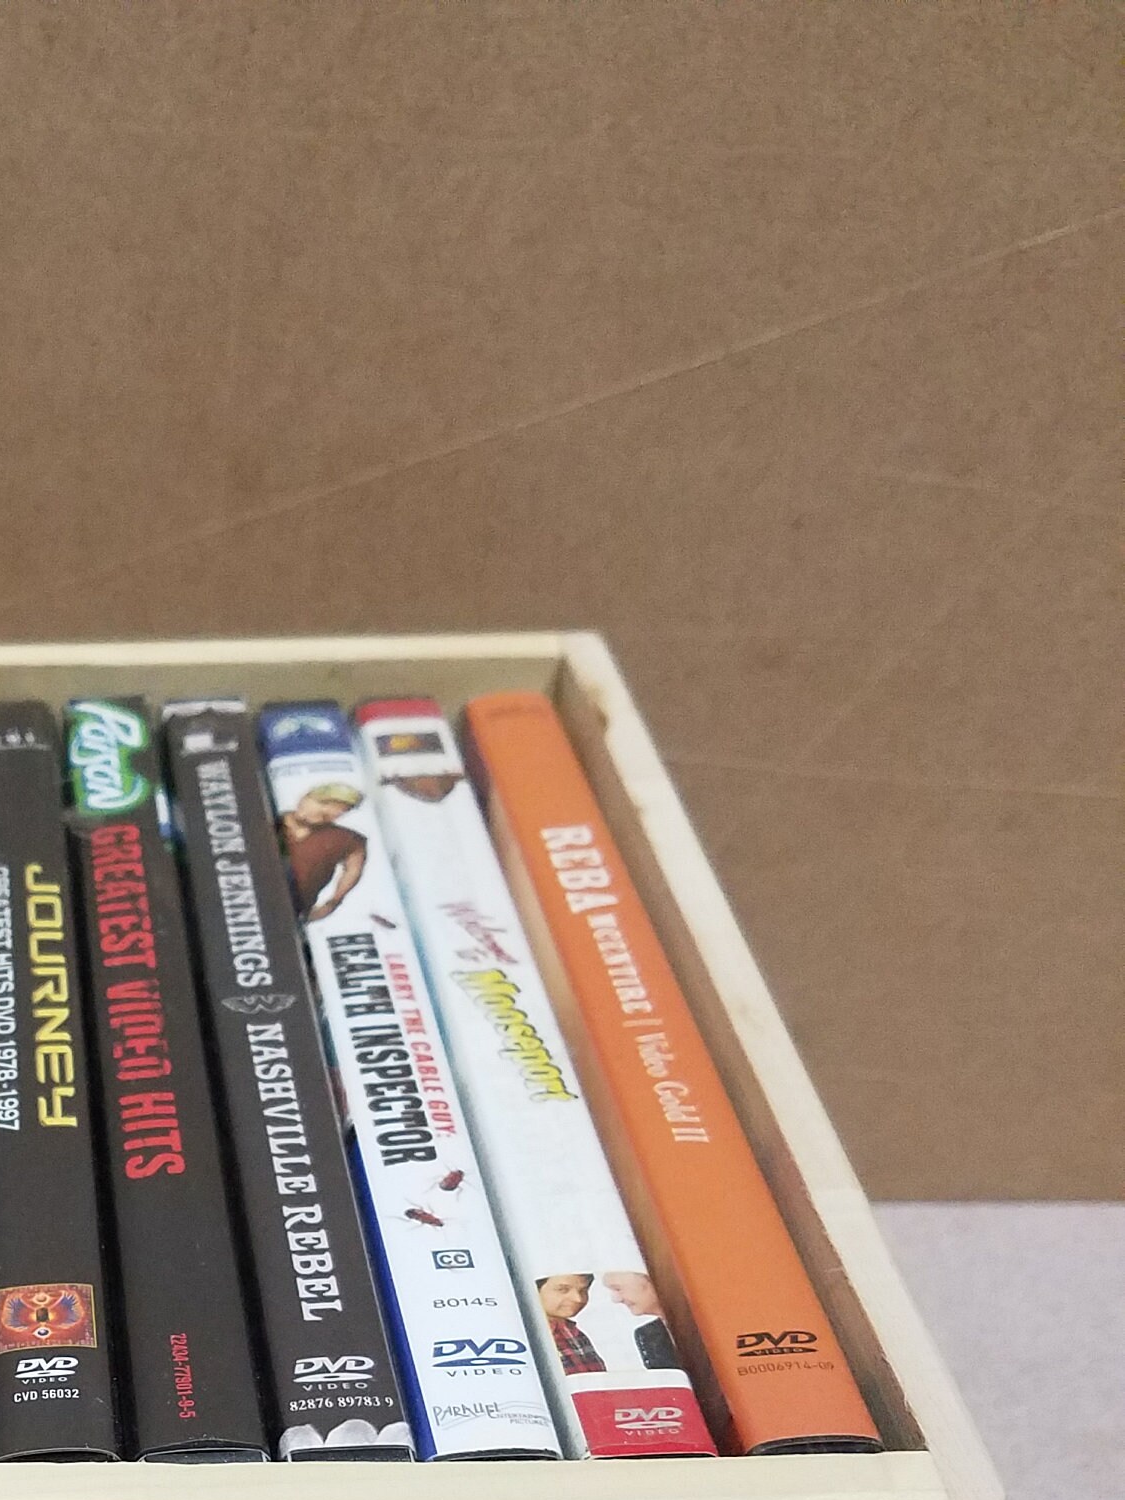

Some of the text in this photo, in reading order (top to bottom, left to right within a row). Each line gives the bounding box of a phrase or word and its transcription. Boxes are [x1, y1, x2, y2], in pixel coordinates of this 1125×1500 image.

[196, 758, 245, 854] WAYLON
[540, 824, 620, 915] REBA
[215, 858, 273, 987] JENNINGS
[26, 864, 78, 1128] JOURNEY
[91, 824, 186, 1180] GREATEST VIDEO HITS
[402, 1008, 427, 1035] THE
[449, 968, 578, 1102] Mooseport
[326, 933, 437, 1167] HEALTH INSPECTOR
[411, 1040, 444, 1094] CABLE
[653, 1081, 701, 1123] Gold
[247, 1022, 343, 1321] NASHVILLE REBEL
[432, 1338, 527, 1358] DVD
[737, 1331, 818, 1349] DVD
[16, 1356, 79, 1373] DVD
[294, 1355, 375, 1375] DVD
[446, 1368, 522, 1377] VIDEO
[21, 1376, 68, 1385] VIDEO
[302, 1382, 368, 1391] VIDEO
[13, 1389, 80, 1402] CVD 56032
[289, 1395, 394, 1412] 82876 89783 9
[614, 1407, 684, 1422] DVD
[624, 1428, 679, 1436] VIDEO
